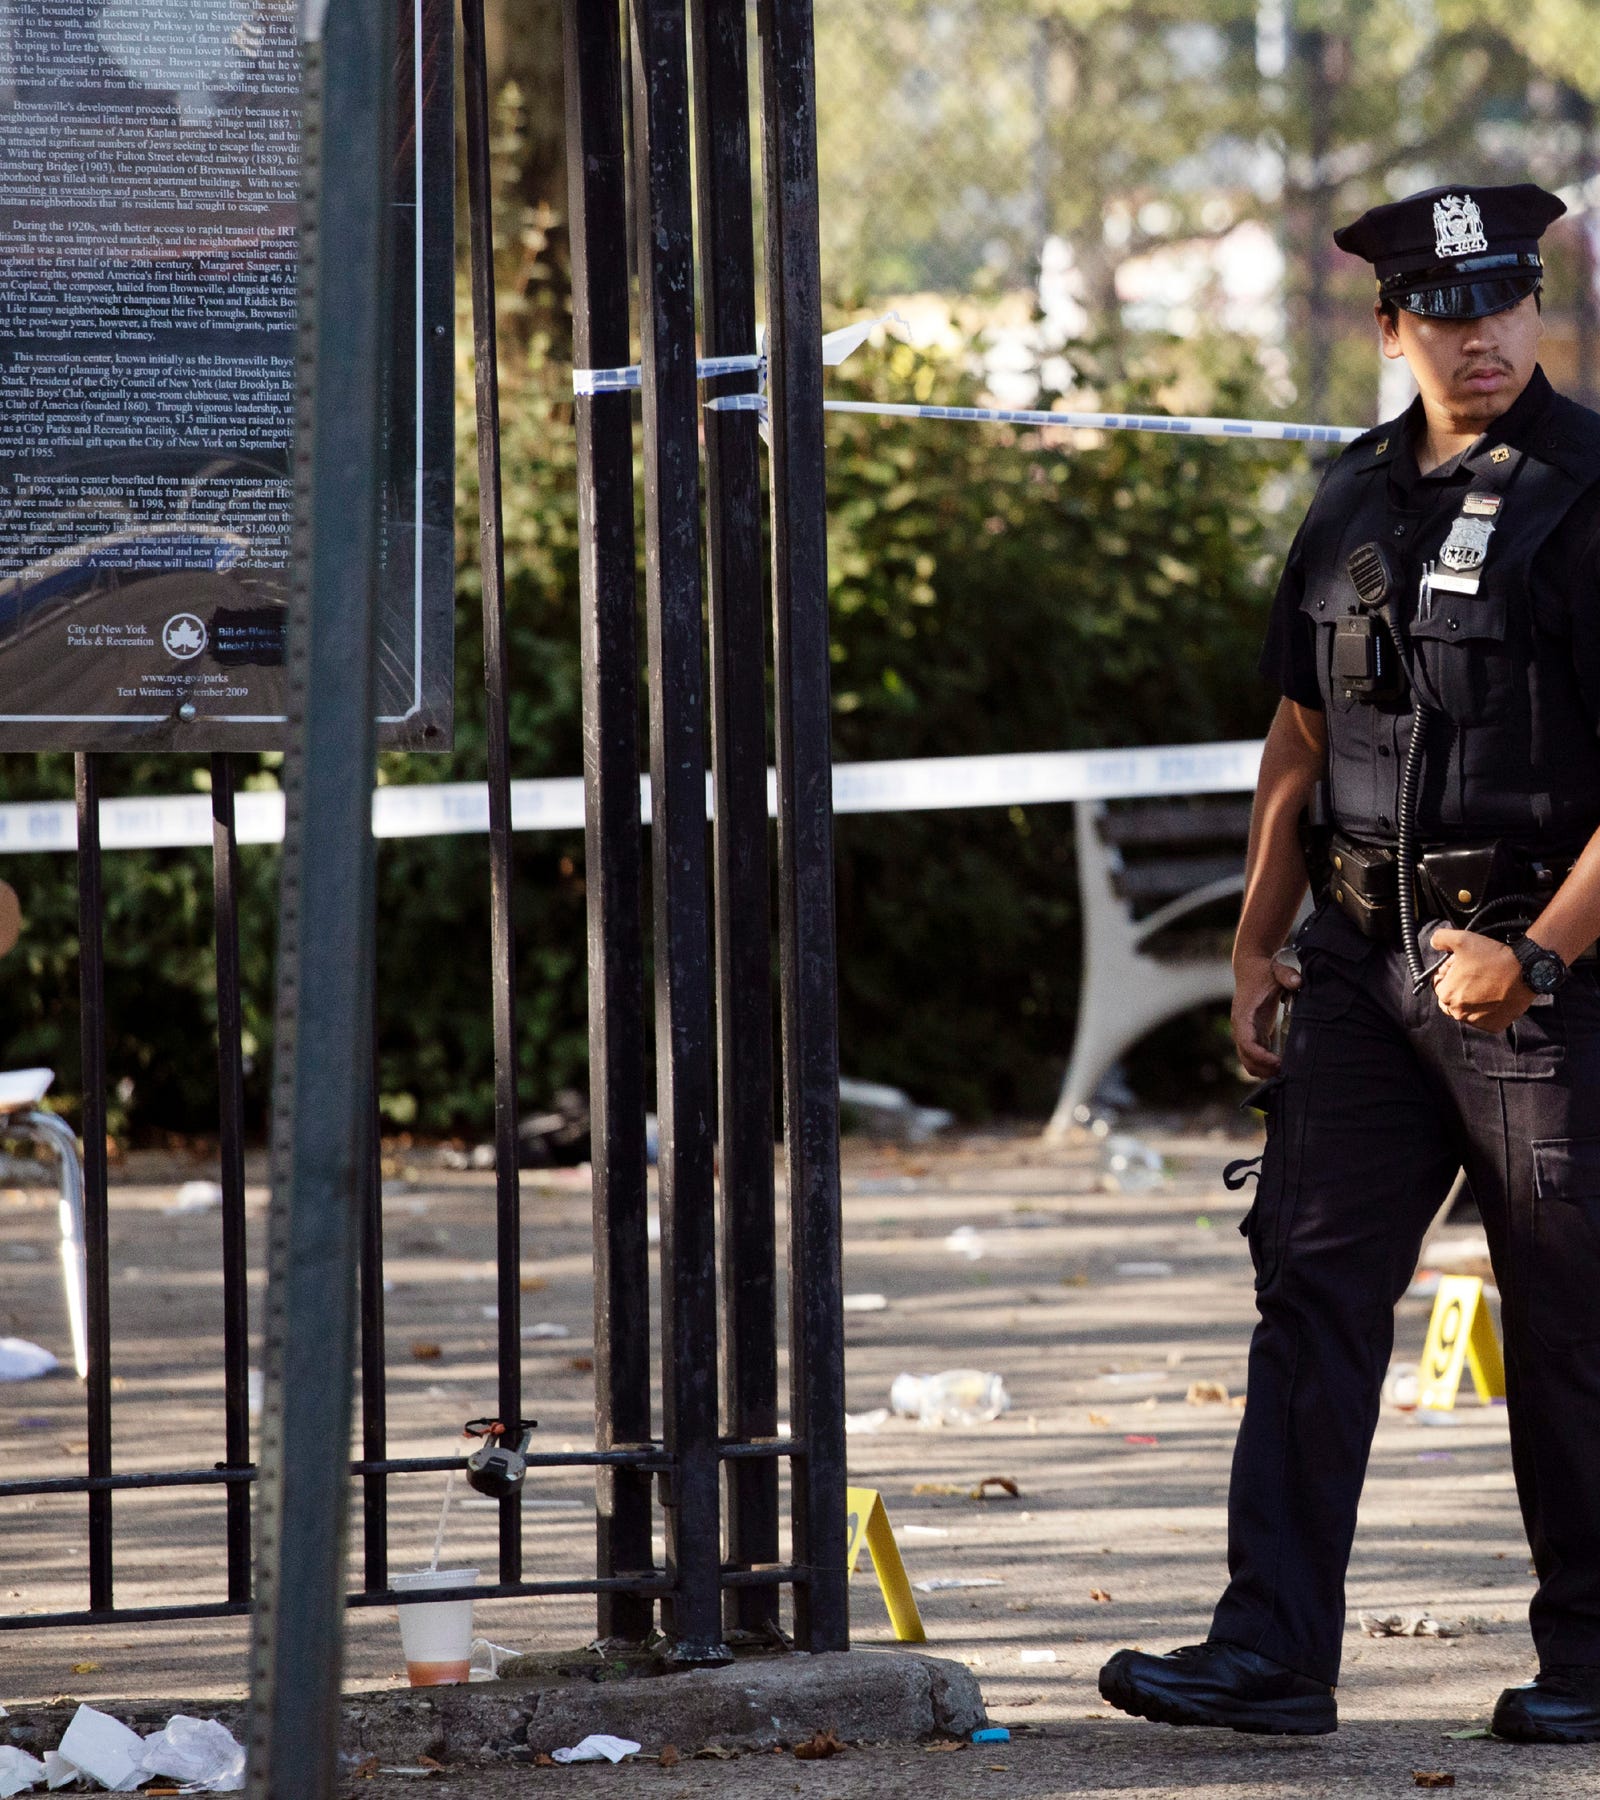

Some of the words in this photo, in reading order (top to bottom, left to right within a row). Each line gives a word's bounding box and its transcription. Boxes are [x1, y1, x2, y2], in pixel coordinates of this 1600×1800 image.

[14, 100, 74, 110] Brownsville's
[76, 102, 133, 114] development
[136, 104, 181, 116] proceeded
[183, 105, 215, 116] slowly,
[217, 106, 242, 117] partly
[245, 107, 280, 116] because
[282, 108, 288, 116] it
[8, 148, 30, 157] With
[32, 149, 46, 158] the
[49, 149, 84, 161] opening
[87, 150, 96, 159] of
[99, 150, 113, 159] the
[116, 151, 145, 160] Fulton
[148, 152, 173, 161] Street
[176, 152, 213, 162] elevated
[216, 153, 249, 165] railway
[251, 154, 283, 166] (1889),
[14, 220, 46, 231] During
[49, 221, 63, 230] the
[68, 221, 97, 232] 1920s,
[100, 222, 121, 231] with
[124, 222, 150, 232] better
[187, 224, 196, 233] to
[199, 224, 222, 235] rapid
[225, 225, 253, 234] transit
[257, 225, 275, 237] (the
[278, 226, 296, 235] IRT
[29, 232, 37, 241] in
[39, 233, 52, 242] the
[76, 233, 117, 245] improved
[119, 234, 163, 246] markedly,
[165, 236, 181, 244] and
[183, 236, 197, 245] the
[198, 236, 258, 248] neighborhood
[64, 245, 91, 254] center
[94, 246, 103, 255] of
[106, 246, 129, 255] labor
[131, 247, 179, 257] radicalism,
[181, 248, 228, 260] supporting
[231, 249, 267, 258] socialist
[37, 257, 51, 266] the
[56, 257, 74, 266] first
[78, 257, 96, 266] half
[100, 258, 109, 267] of
[113, 258, 127, 267] the
[131, 259, 152, 268] 20th
[156, 259, 193, 271] century.
[200, 260, 243, 272] Margaret
[247, 261, 281, 273] Sanger,
[11, 280, 50, 291] Copland,
[53, 281, 67, 290] the
[69, 283, 114, 293] composer,
[117, 282, 143, 291] hailed
[146, 283, 167, 292] from
[170, 283, 225, 294] Brownsville,
[227, 284, 269, 296] alongside
[0, 292, 28, 301] Alfred
[30, 292, 58, 301] Kazin.
[63, 293, 121, 305] Heavyweight
[123, 294, 170, 306] champions
[173, 295, 195, 304] Mike
[197, 296, 224, 307] Tyson
[226, 296, 241, 305] and
[243, 296, 277, 306] Riddick
[7, 304, 27, 313] Like
[29, 306, 53, 315] many
[55, 305, 119, 317] neighborhoods
[121, 306, 169, 318] throughout
[171, 307, 184, 316] the
[187, 307, 203, 316] five
[205, 308, 248, 319] boroughs,
[19, 328, 34, 337] has
[37, 328, 71, 340] brought
[74, 329, 112, 338] renewed
[114, 330, 155, 341] vibrancy.
[14, 352, 33, 360] This
[36, 352, 80, 361] recreation
[83, 353, 113, 363] center,
[115, 353, 146, 362] known
[149, 354, 183, 365] initially
[198, 355, 211, 364] the
[214, 355, 268, 365] Brownsville
[2, 375, 28, 385] Stark,
[30, 376, 70, 385] President
[72, 377, 81, 385] of
[84, 377, 97, 386] the
[99, 377, 118, 388] City
[120, 377, 155, 386] Council
[157, 378, 166, 387] of
[169, 378, 189, 387] New
[191, 378, 213, 387] York
[214, 379, 237, 390] (later
[239, 379, 280, 391] Brooklyn
[13, 473, 30, 482] The
[34, 474, 79, 483] recreation
[81, 474, 109, 483] center
[112, 475, 154, 484] benefited
[157, 475, 178, 484] from
[181, 475, 208, 486] major
[210, 476, 262, 485] renovations
[17, 485, 26, 494] In
[28, 485, 54, 495] 1996,
[57, 486, 77, 494] with
[81, 486, 123, 497] $400,000
[126, 486, 134, 495] in
[138, 487, 162, 496] funds
[165, 487, 187, 496] from
[190, 487, 229, 498] Borough
[232, 488, 273, 497] President
[1445, 547, 1475, 565] 6344
[68, 624, 88, 634] City
[90, 624, 100, 633] of
[102, 625, 122, 634] New
[126, 625, 147, 634] York
[68, 636, 95, 646] Parks
[96, 636, 103, 646] &
[106, 636, 154, 646] Recreation
[116, 688, 136, 696] Text
[139, 688, 174, 696] Written:
[176, 688, 224, 697] Seember
[226, 688, 248, 697] 2009
[1430, 1297, 1462, 1379] 9
